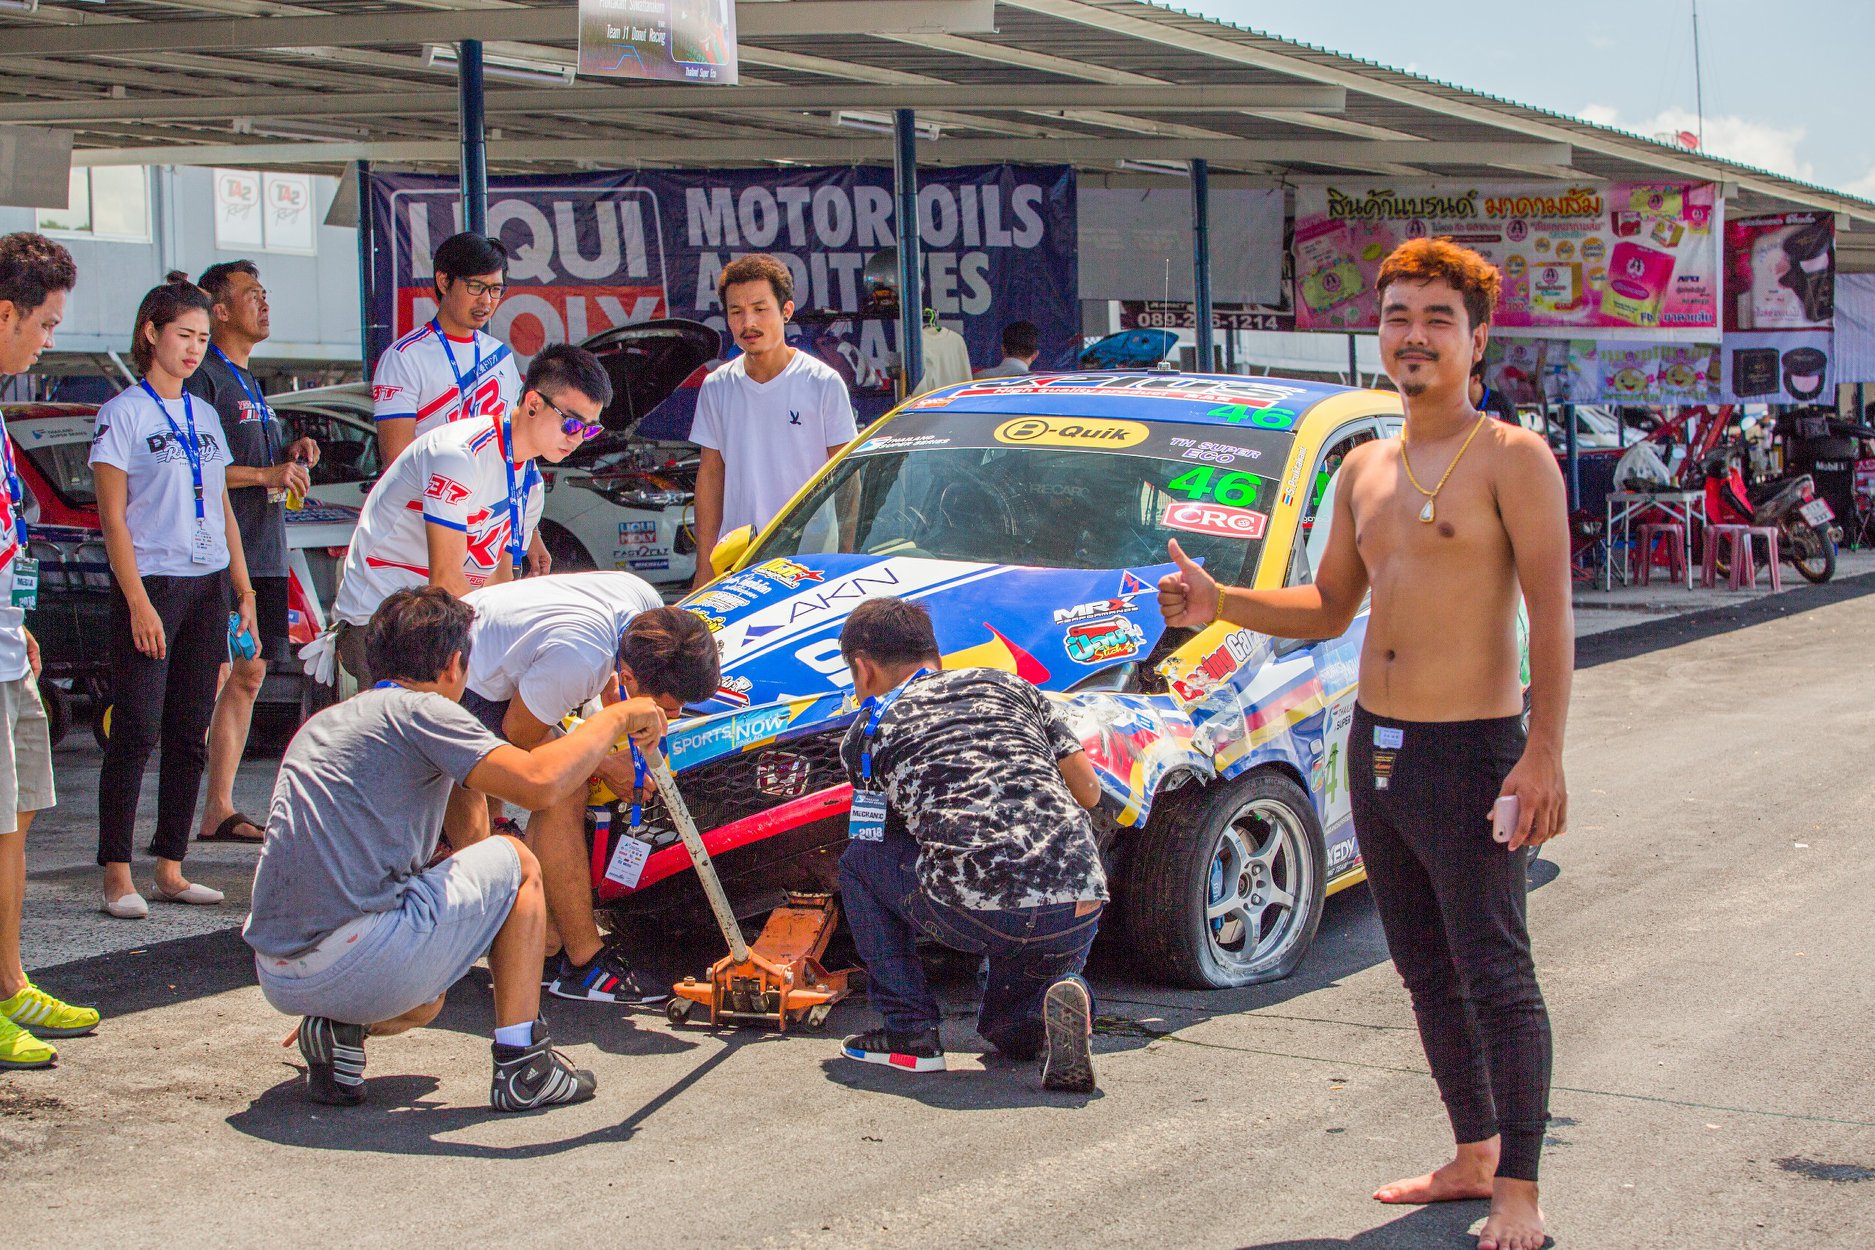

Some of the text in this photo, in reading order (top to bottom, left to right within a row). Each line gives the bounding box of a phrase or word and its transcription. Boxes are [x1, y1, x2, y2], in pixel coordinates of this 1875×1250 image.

[606, 24, 621, 39] Team
[631, 27, 647, 42] Donut
[648, 28, 667, 46] Racing
[685, 184, 1044, 249] MOTOR OILS
[1137, 312, 1279, 330] 089-26-1214
[993, 386, 1169, 396] High quality product
[1206, 403, 1296, 428] 46
[1169, 437, 1262, 459] TH SUPER
[1181, 448, 1235, 464] ECO
[424, 473, 472, 505] 37
[1168, 465, 1262, 507] 46
[619, 522, 655, 532] LIQUI
[1172, 505, 1255, 533] CRC
[620, 532, 657, 543] MOLY
[790, 567, 900, 624] AKN
[1053, 595, 1138, 621] MRX
[1094, 642, 1136, 662] Sticker
[672, 716, 784, 755] SPORTS NOW
[852, 809, 884, 820] MECHANIC
[858, 826, 883, 839] 2018
